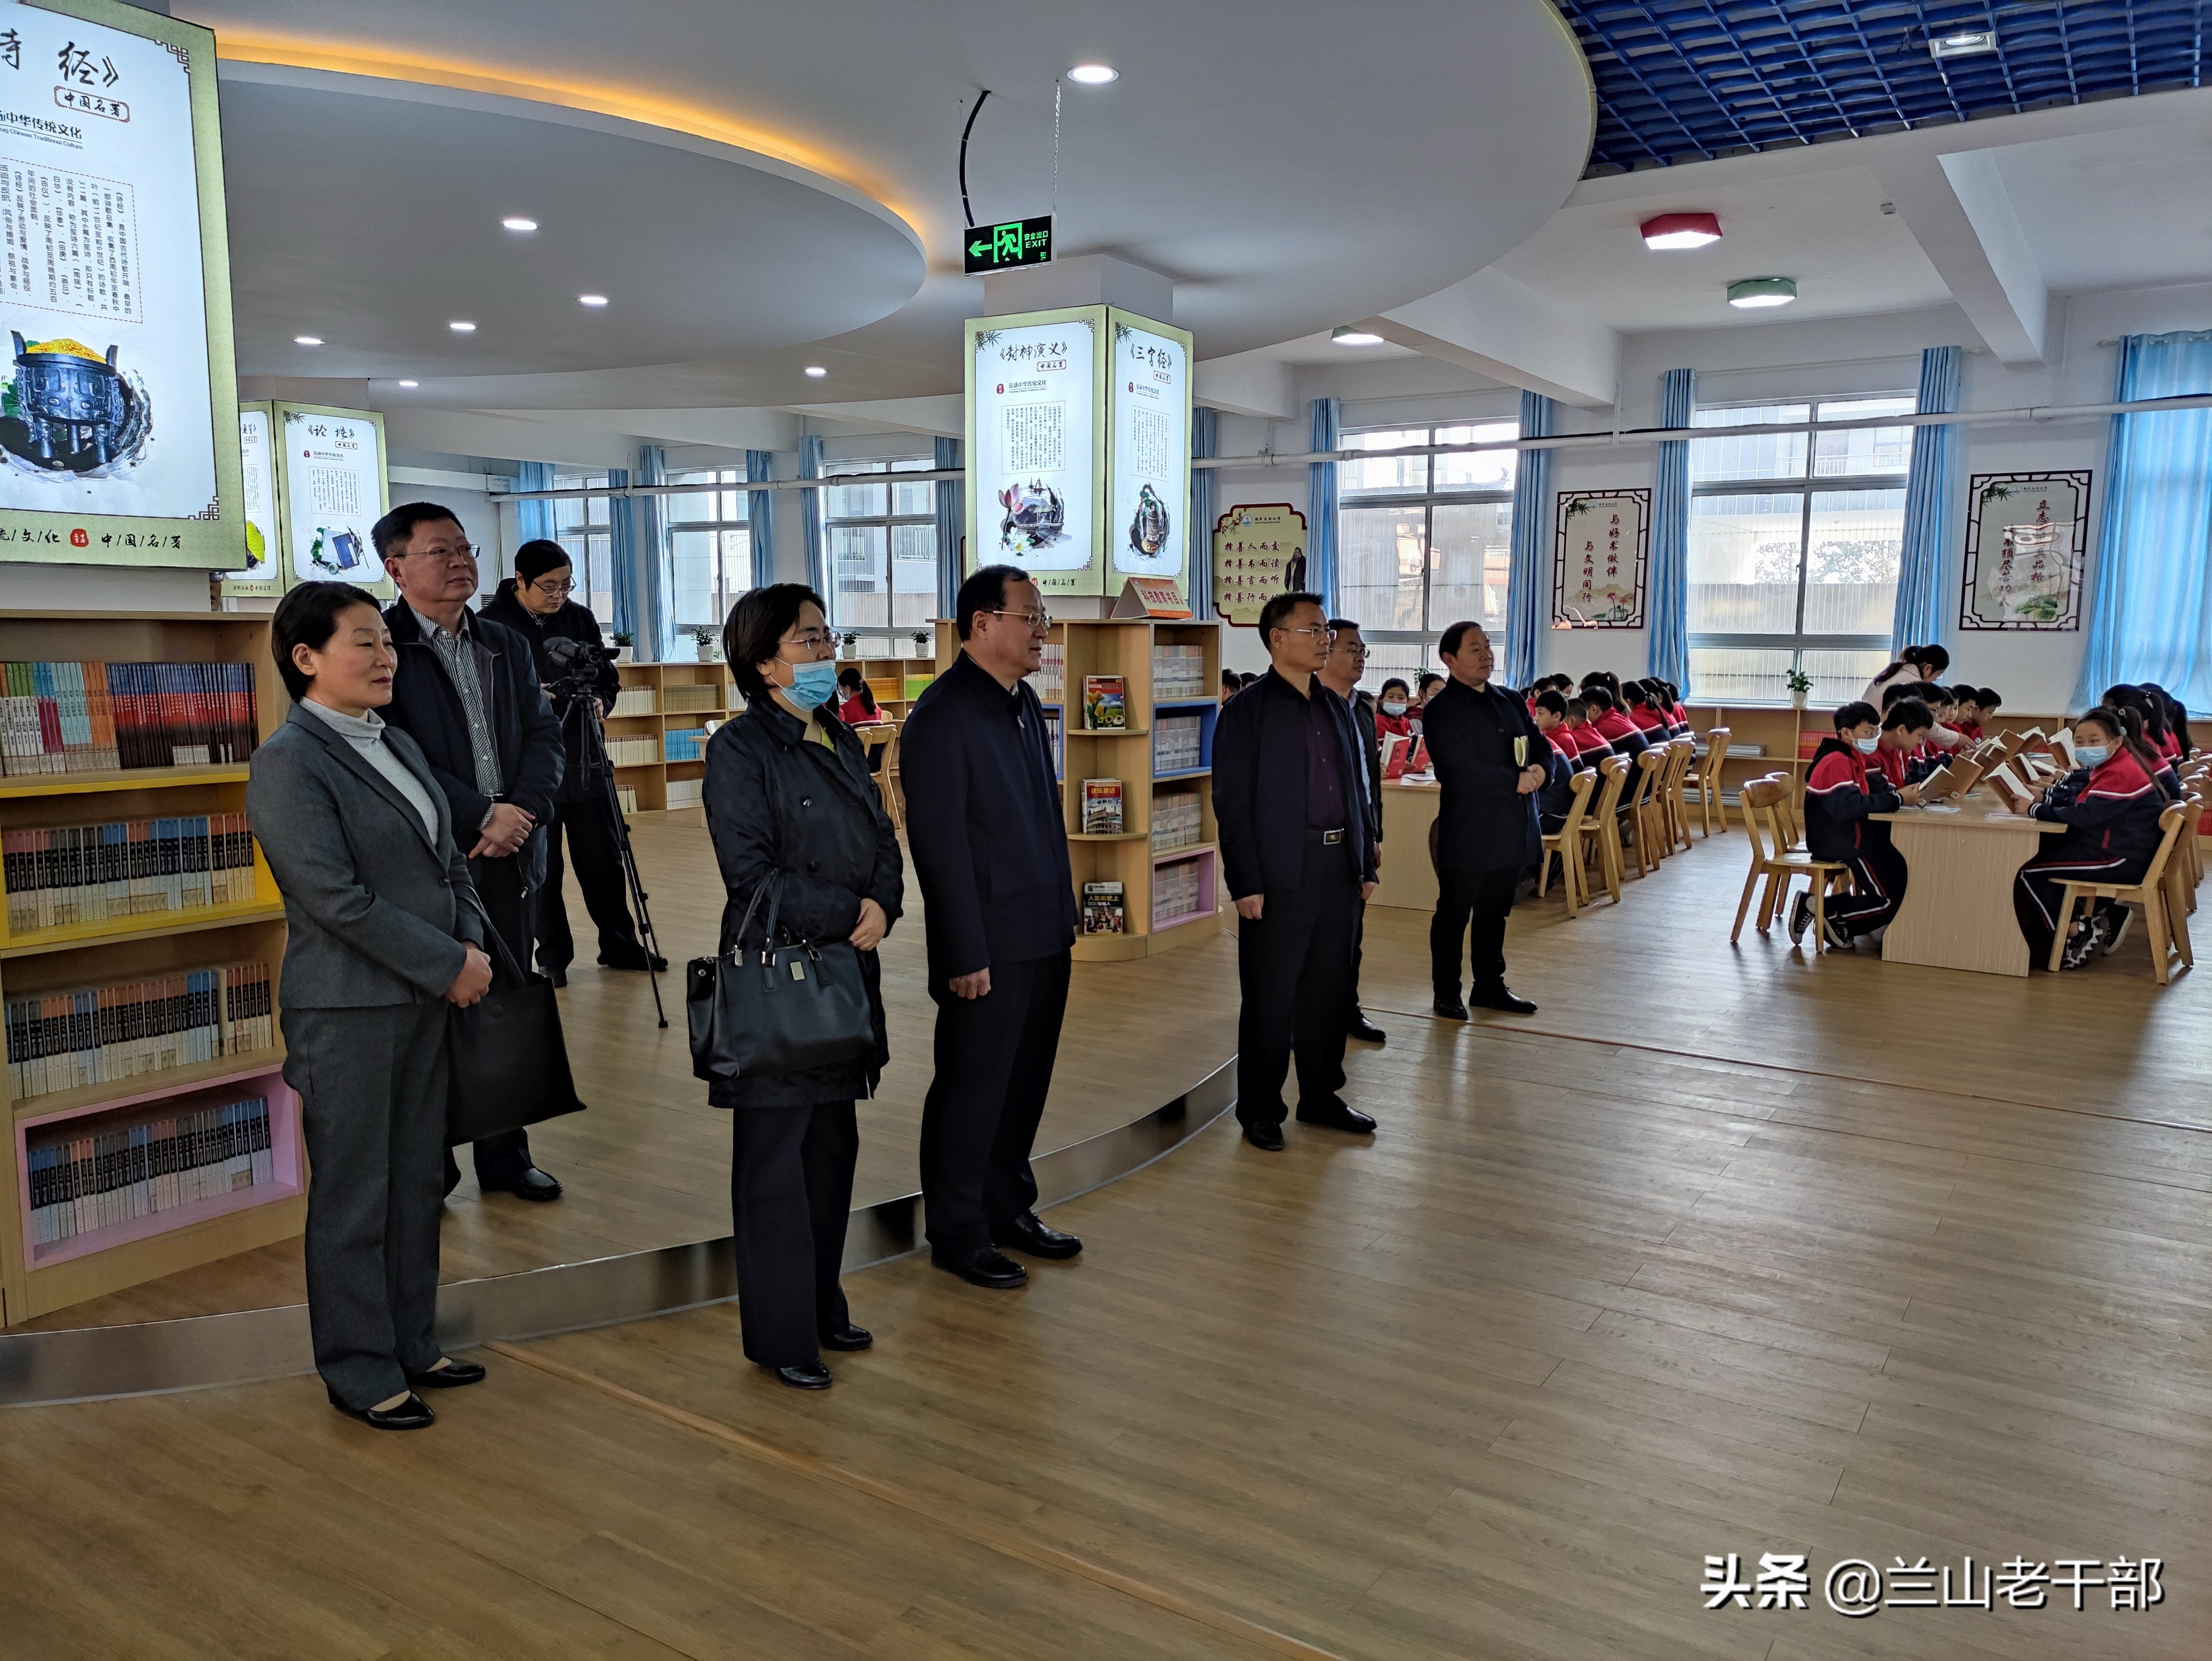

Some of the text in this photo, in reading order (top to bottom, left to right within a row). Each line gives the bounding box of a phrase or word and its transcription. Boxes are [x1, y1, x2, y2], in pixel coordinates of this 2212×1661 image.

[64, 92, 122, 118] 中国名著
[33, 133, 63, 145] Traditional
[63, 141, 83, 150] Culture
[1024, 231, 1048, 241] 安全出口
[1026, 239, 1047, 248] EXIT
[1000, 341, 1067, 361] 《封神演义》
[1130, 343, 1172, 369] 《三字经》
[308, 424, 354, 440] 《论语》
[1224, 541, 1280, 553] 择善人而交
[1606, 514, 1620, 577] 与好书做伴
[1224, 558, 1280, 570] 择善书而读
[1582, 541, 1593, 602] 与文明同行
[1224, 574, 1280, 587] 择善言而听
